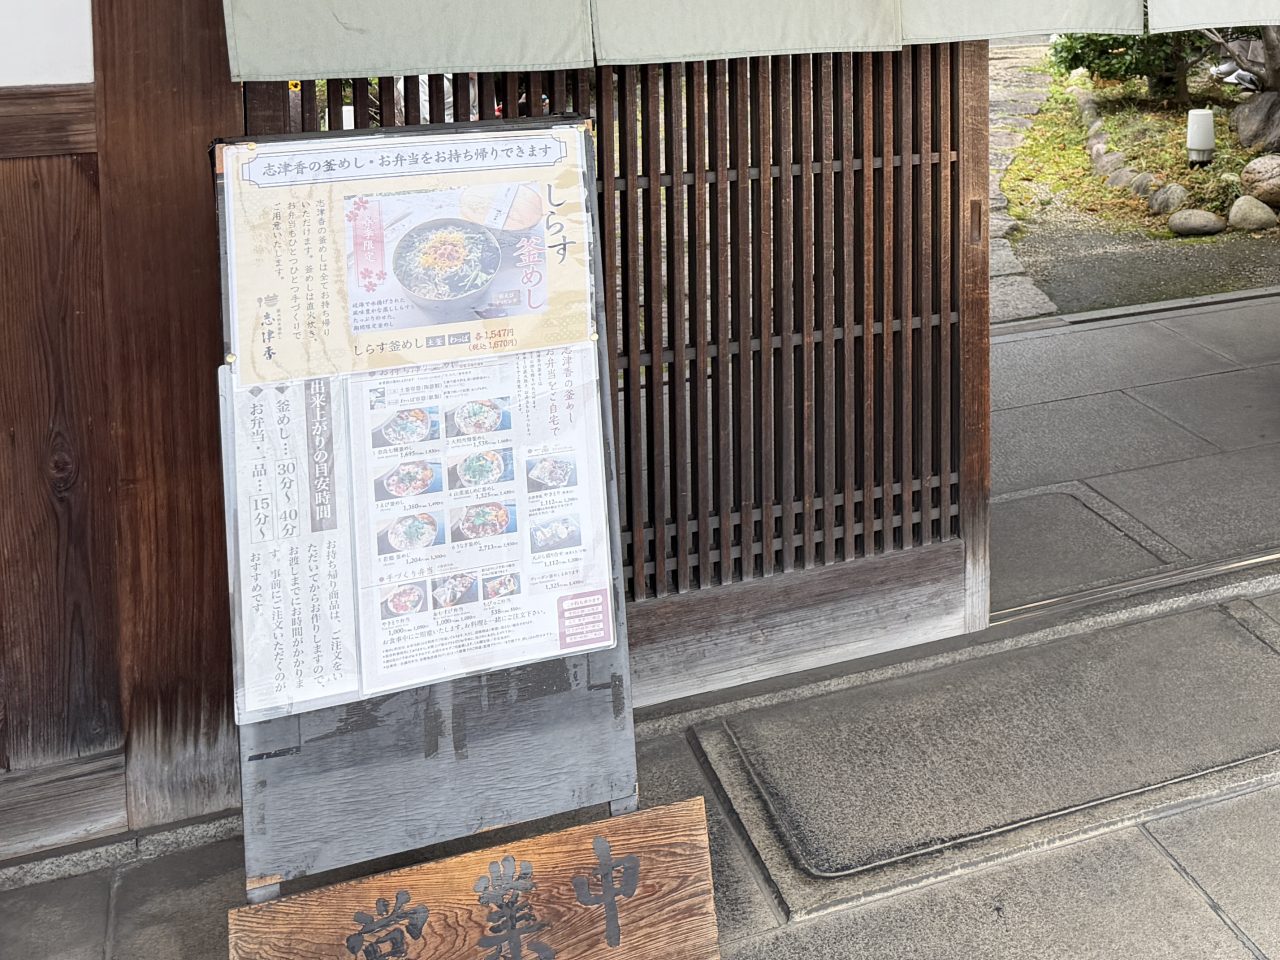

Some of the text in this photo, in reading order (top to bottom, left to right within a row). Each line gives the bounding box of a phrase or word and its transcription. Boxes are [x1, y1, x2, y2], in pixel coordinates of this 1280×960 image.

[263, 144, 552, 177] 志津香の釜めし・お弁当をお持ち帰りできます
[272, 202, 285, 280] ご用意いたします。
[546, 183, 577, 265] しらす
[287, 202, 303, 340] お弁当もひとつひとつ手づくりで
[317, 199, 330, 337] 志津香の釜めしは全てお持ち帰り
[513, 236, 546, 310] 釜めし
[261, 311, 278, 361] 志津香
[354, 337, 424, 357] しらす釜めし
[449, 333, 470, 345] わっぱ
[310, 379, 332, 521] 出来上がりの目安時間
[250, 553, 264, 616] おすすめです。
[386, 566, 433, 582] 手づくり弁当
